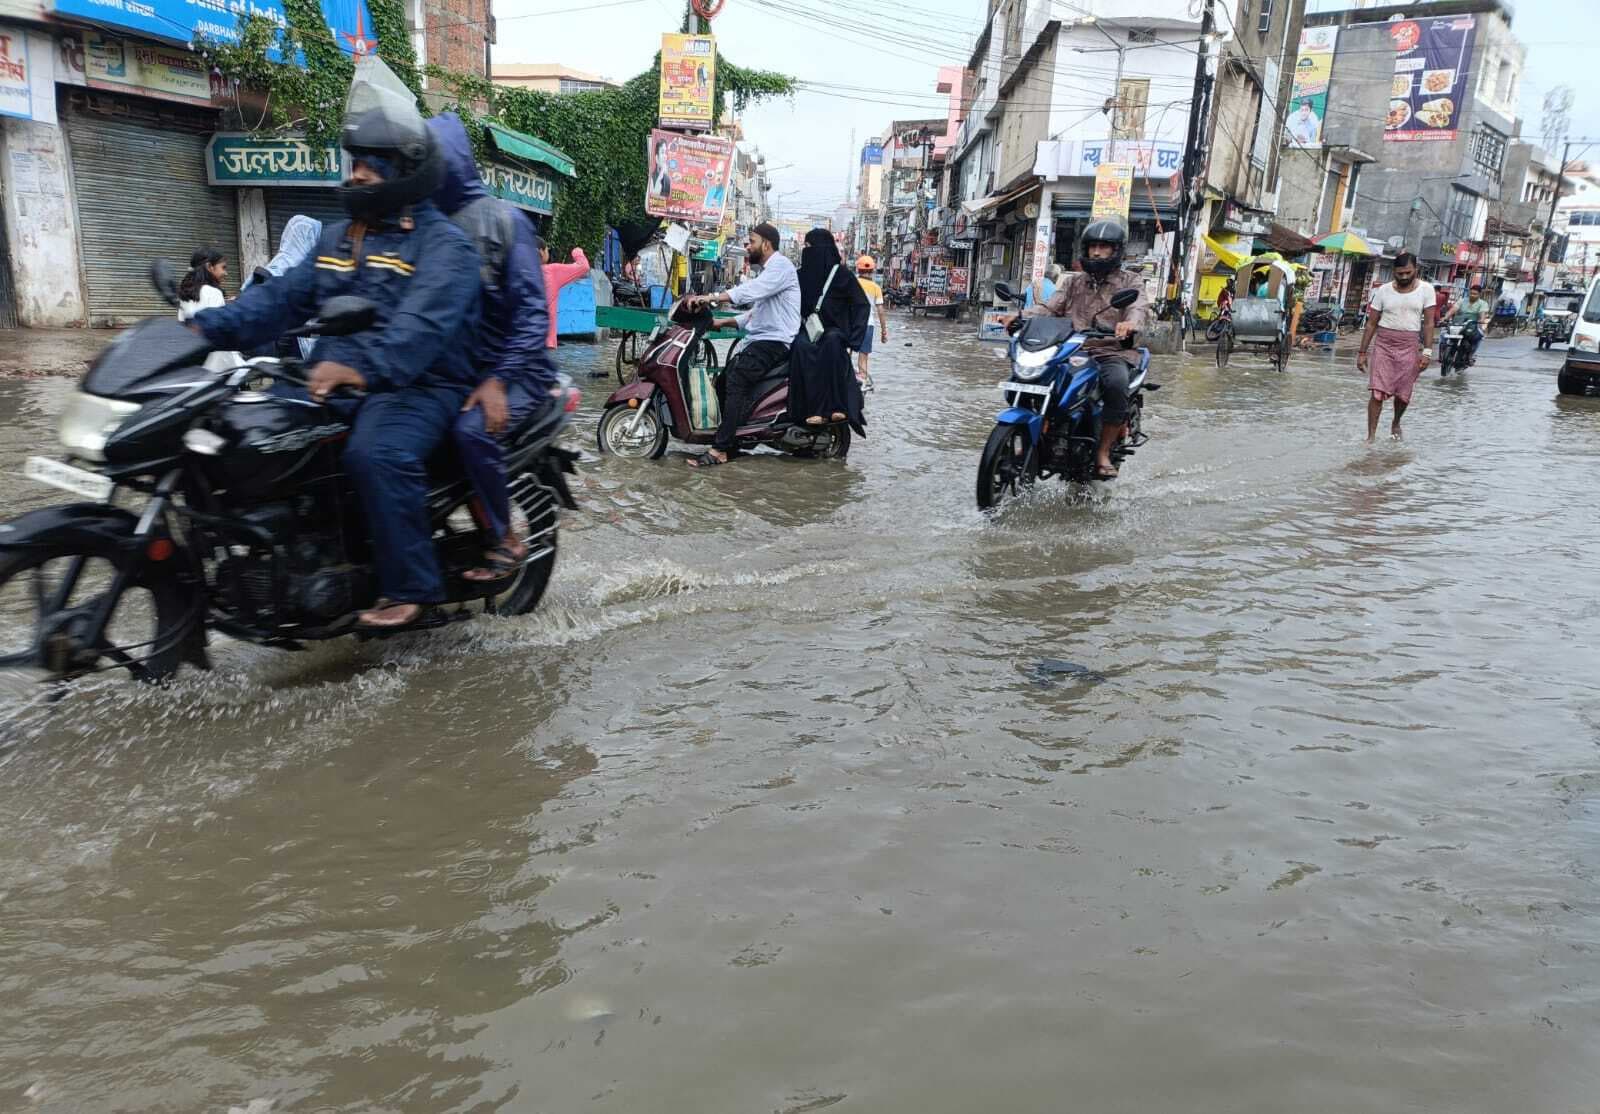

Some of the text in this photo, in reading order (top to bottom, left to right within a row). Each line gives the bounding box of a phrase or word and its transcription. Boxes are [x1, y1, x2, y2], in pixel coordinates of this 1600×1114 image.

[250, 0, 287, 29] India
[1083, 147, 1103, 167] न्यू
[1157, 149, 1180, 169] घर
